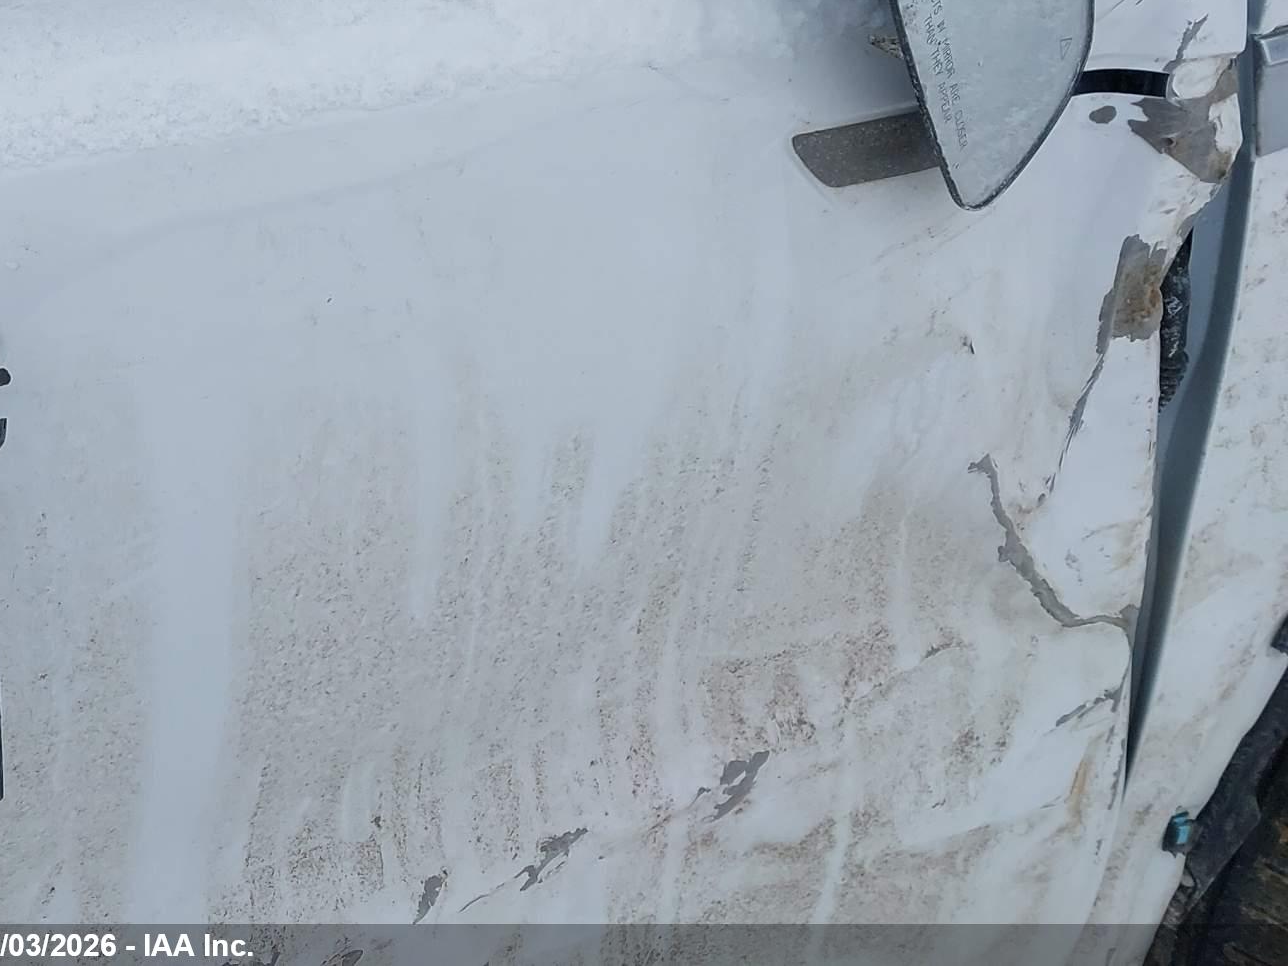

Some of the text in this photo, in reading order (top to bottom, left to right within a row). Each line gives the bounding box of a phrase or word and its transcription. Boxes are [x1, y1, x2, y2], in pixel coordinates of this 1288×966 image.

[924, 14, 952, 125] THAN THEY APPEAR
[942, 37, 956, 80] MIRROR
[949, 83, 961, 105] ARE
[955, 109, 969, 150] CLOSER
